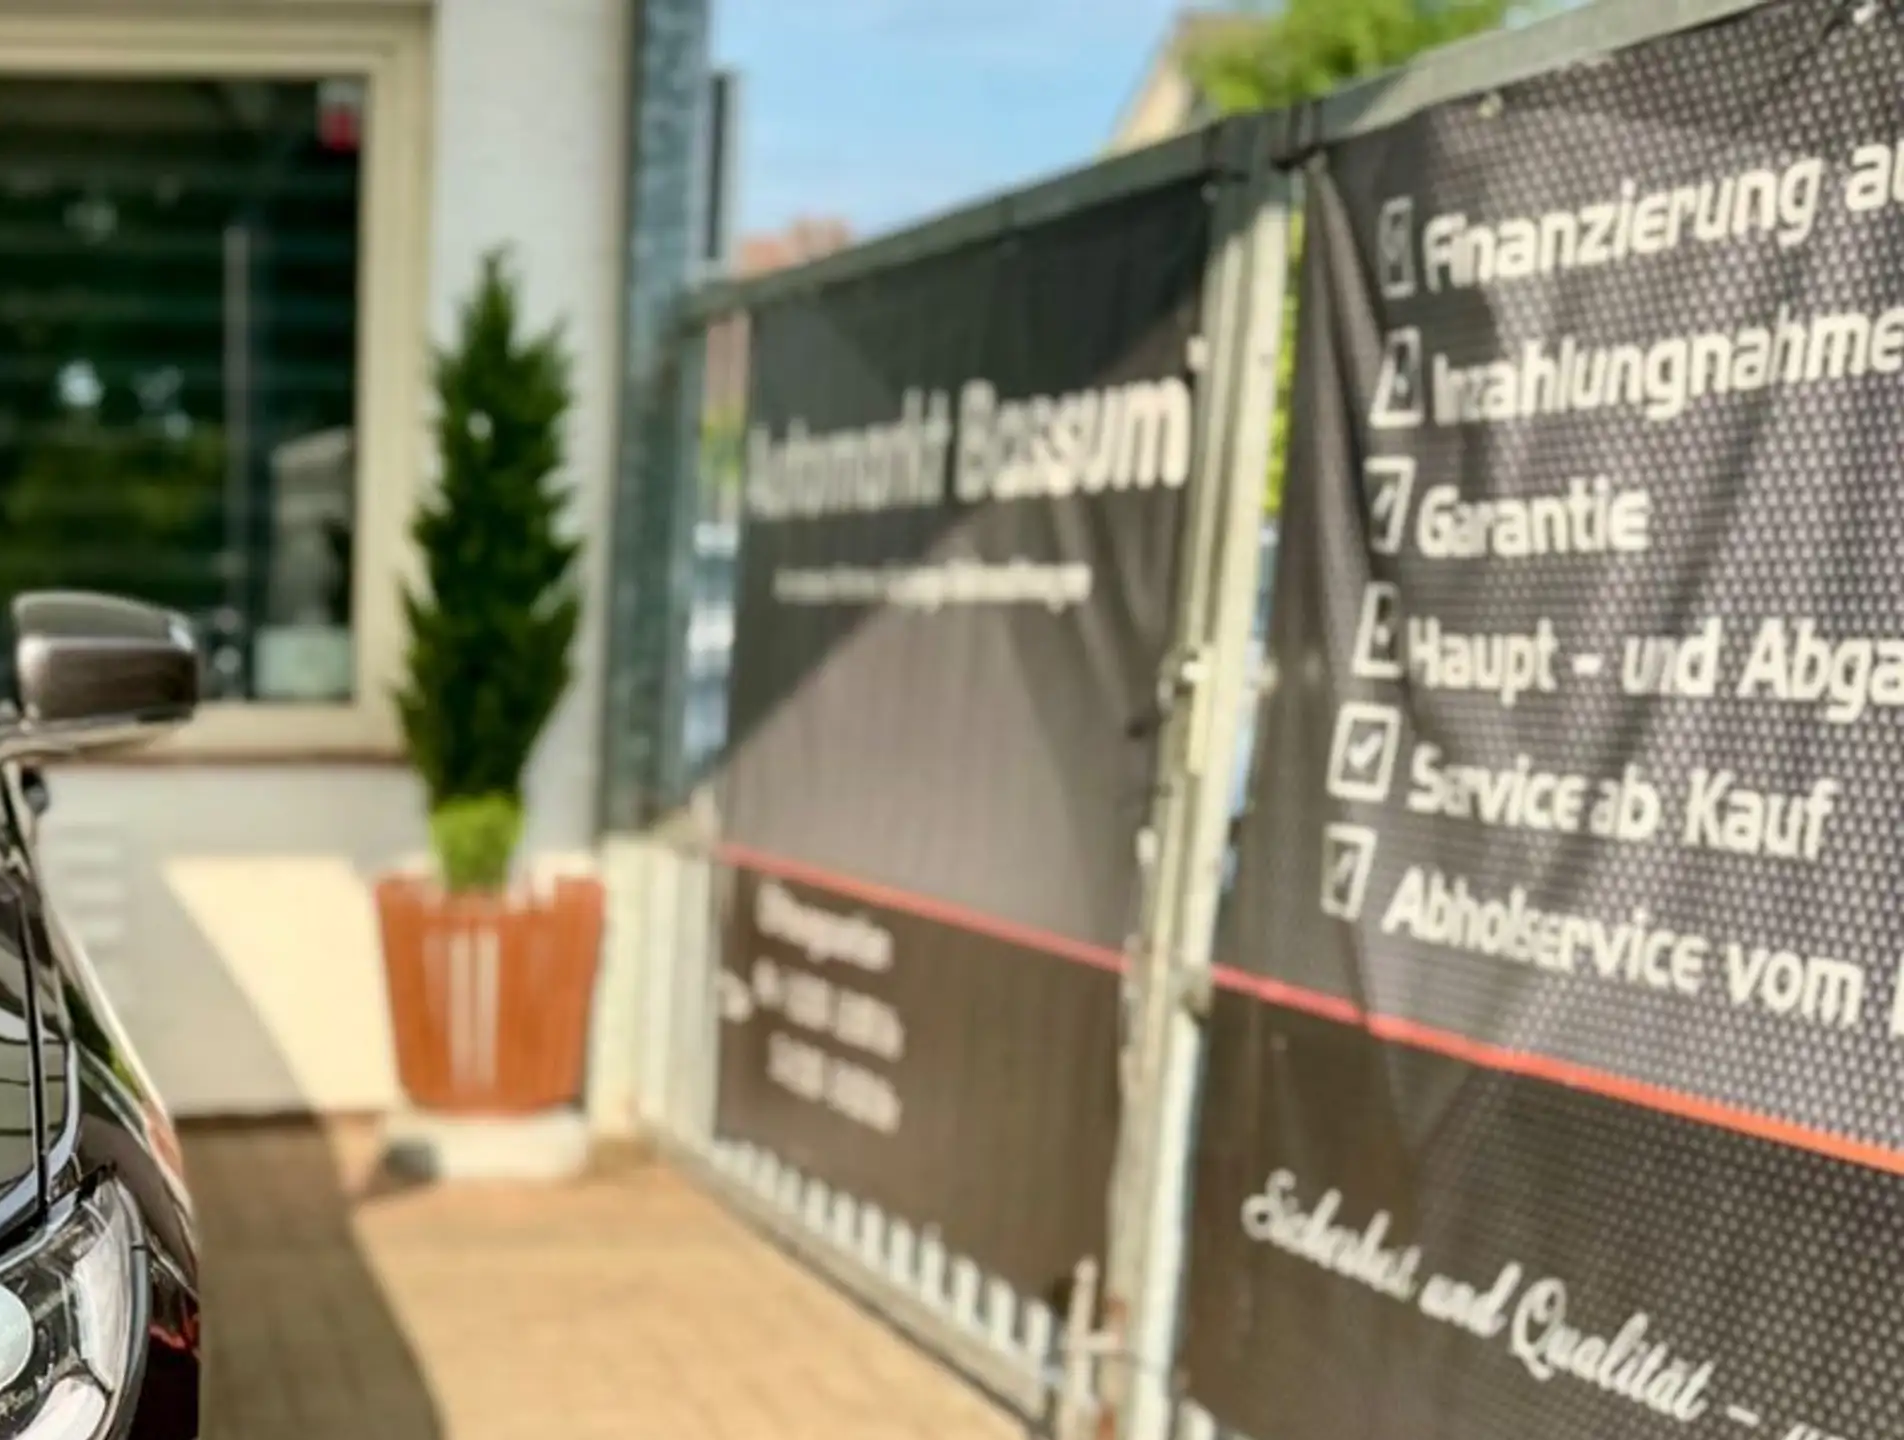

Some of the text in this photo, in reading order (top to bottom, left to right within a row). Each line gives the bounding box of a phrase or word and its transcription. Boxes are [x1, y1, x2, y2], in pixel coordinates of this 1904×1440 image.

[1416, 474, 1654, 559] Garantie
[1407, 616, 1560, 708] Haupt
[1404, 744, 1839, 863] Service ab Kauf
[1381, 864, 1711, 995] Abholservice
[1727, 941, 1865, 1032] vom
